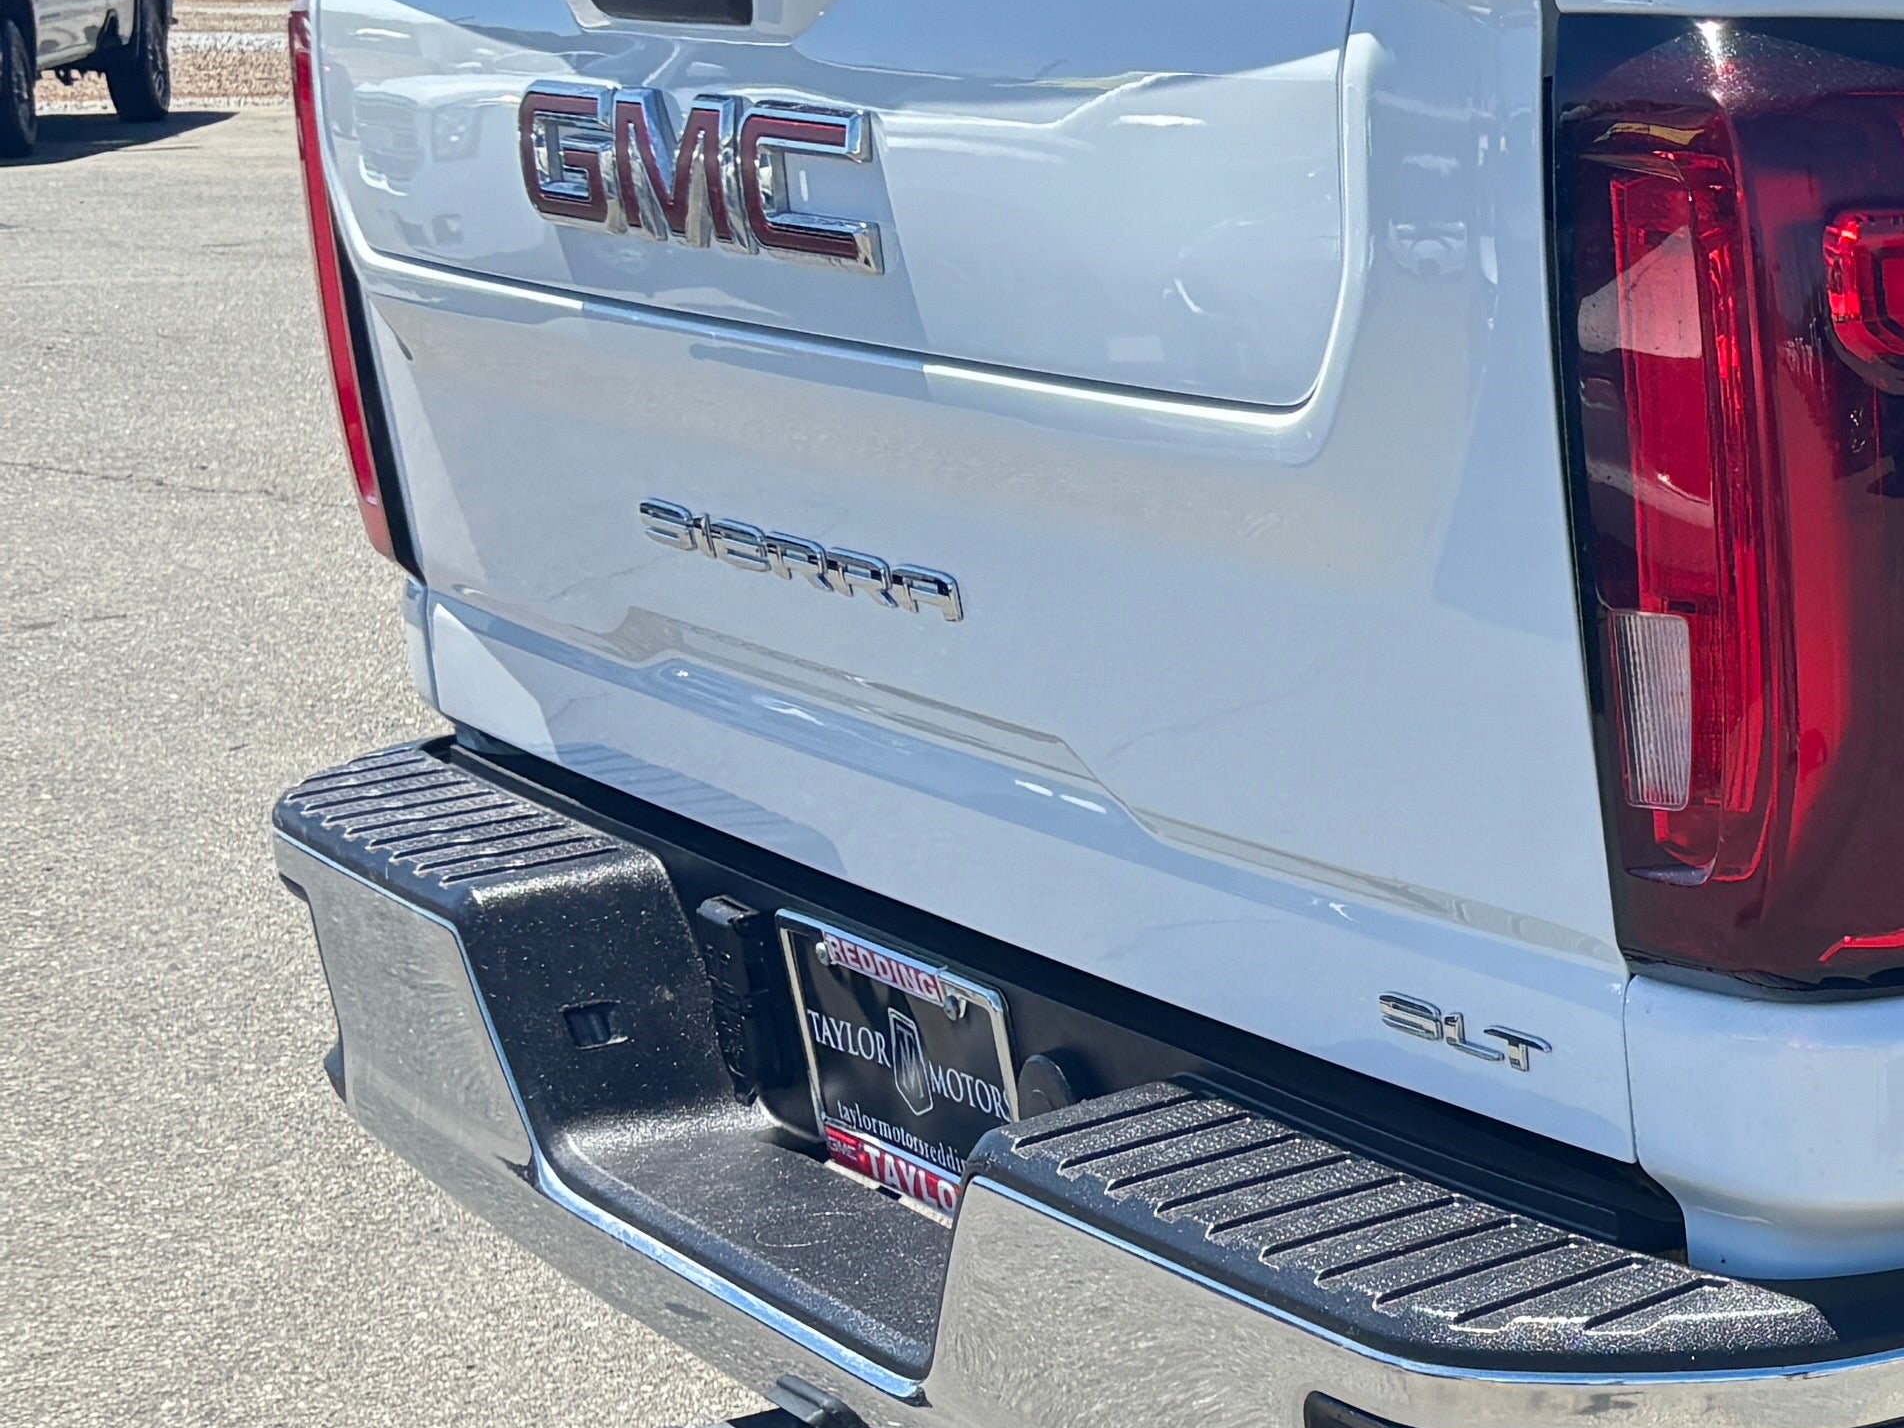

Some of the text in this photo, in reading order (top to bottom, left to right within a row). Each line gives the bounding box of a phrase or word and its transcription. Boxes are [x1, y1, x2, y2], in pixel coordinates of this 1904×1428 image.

[518, 79, 886, 275] GMC
[639, 497, 965, 623] SIERRA
[827, 934, 940, 1001] REDDING
[807, 1009, 892, 1068] TAYLOR
[1378, 990, 1553, 1072] SLT
